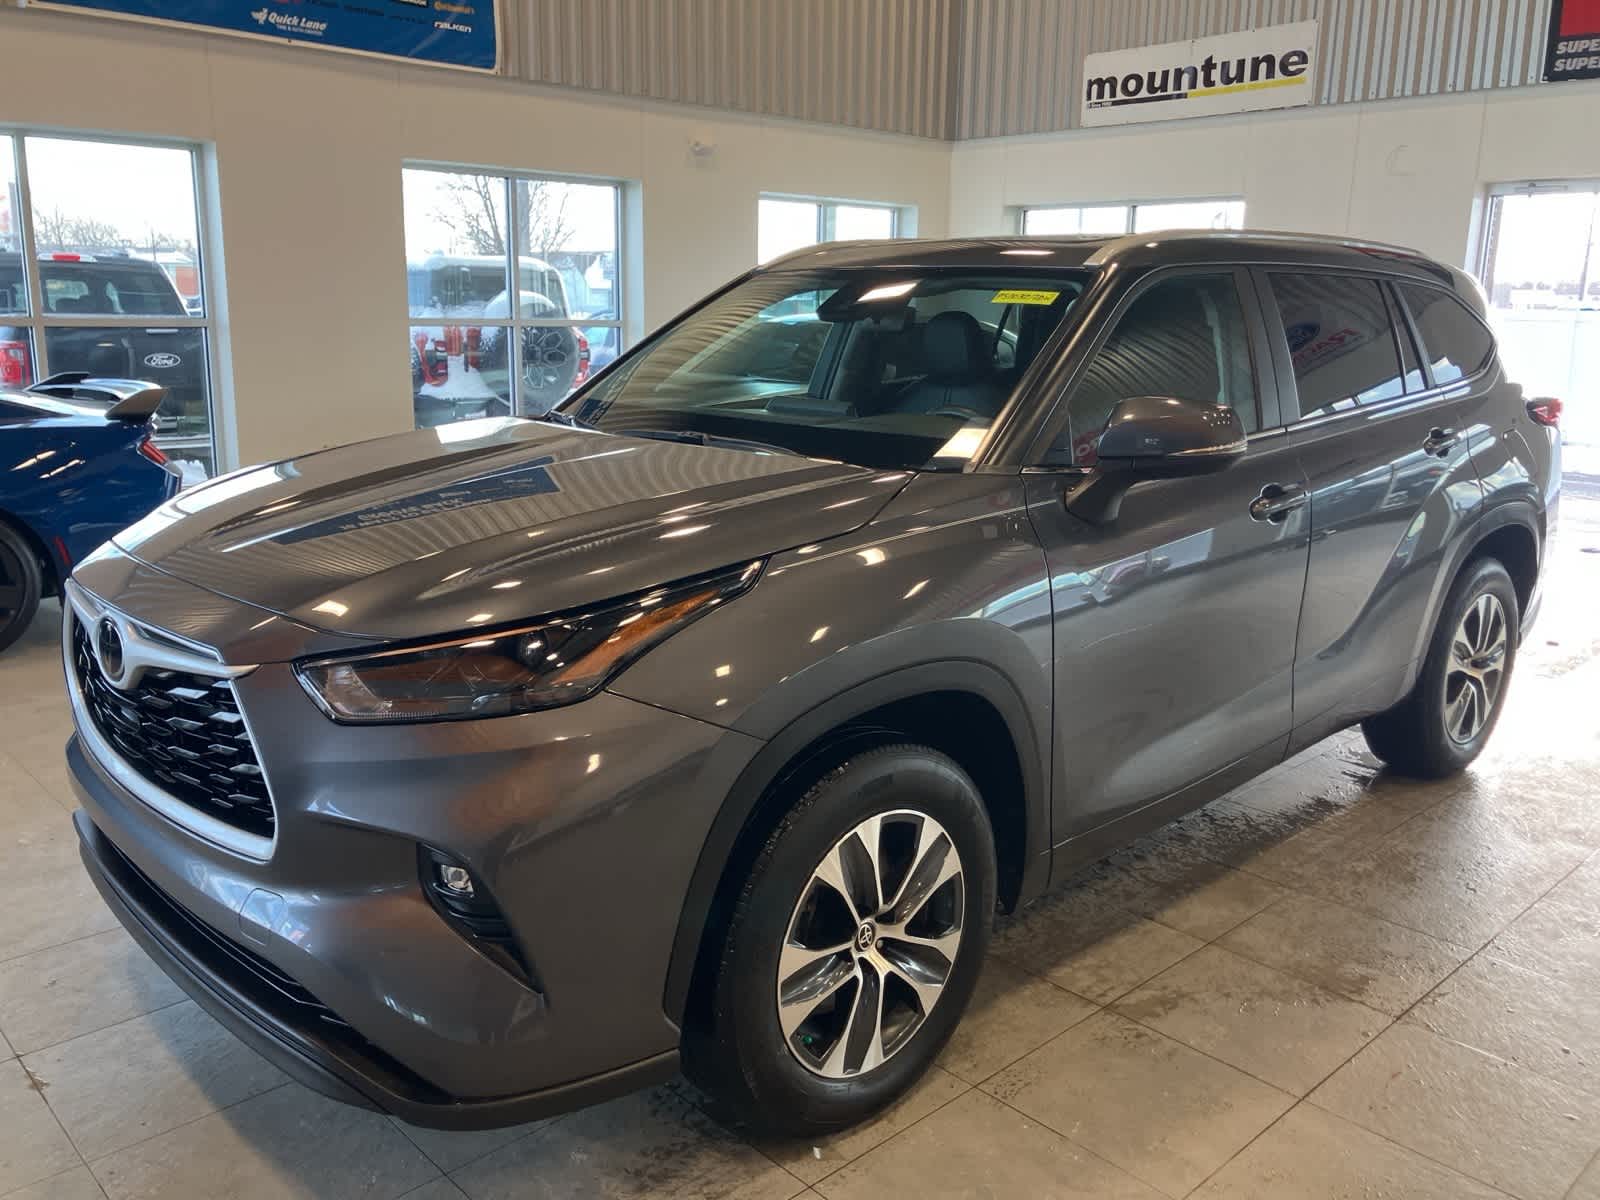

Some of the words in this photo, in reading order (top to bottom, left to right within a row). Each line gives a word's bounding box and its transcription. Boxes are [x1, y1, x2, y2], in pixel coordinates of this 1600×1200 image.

[267, 11, 301, 26] Quick
[300, 17, 328, 31] Lane
[1086, 49, 1309, 101] mountune
[150, 354, 175, 367] Ford
